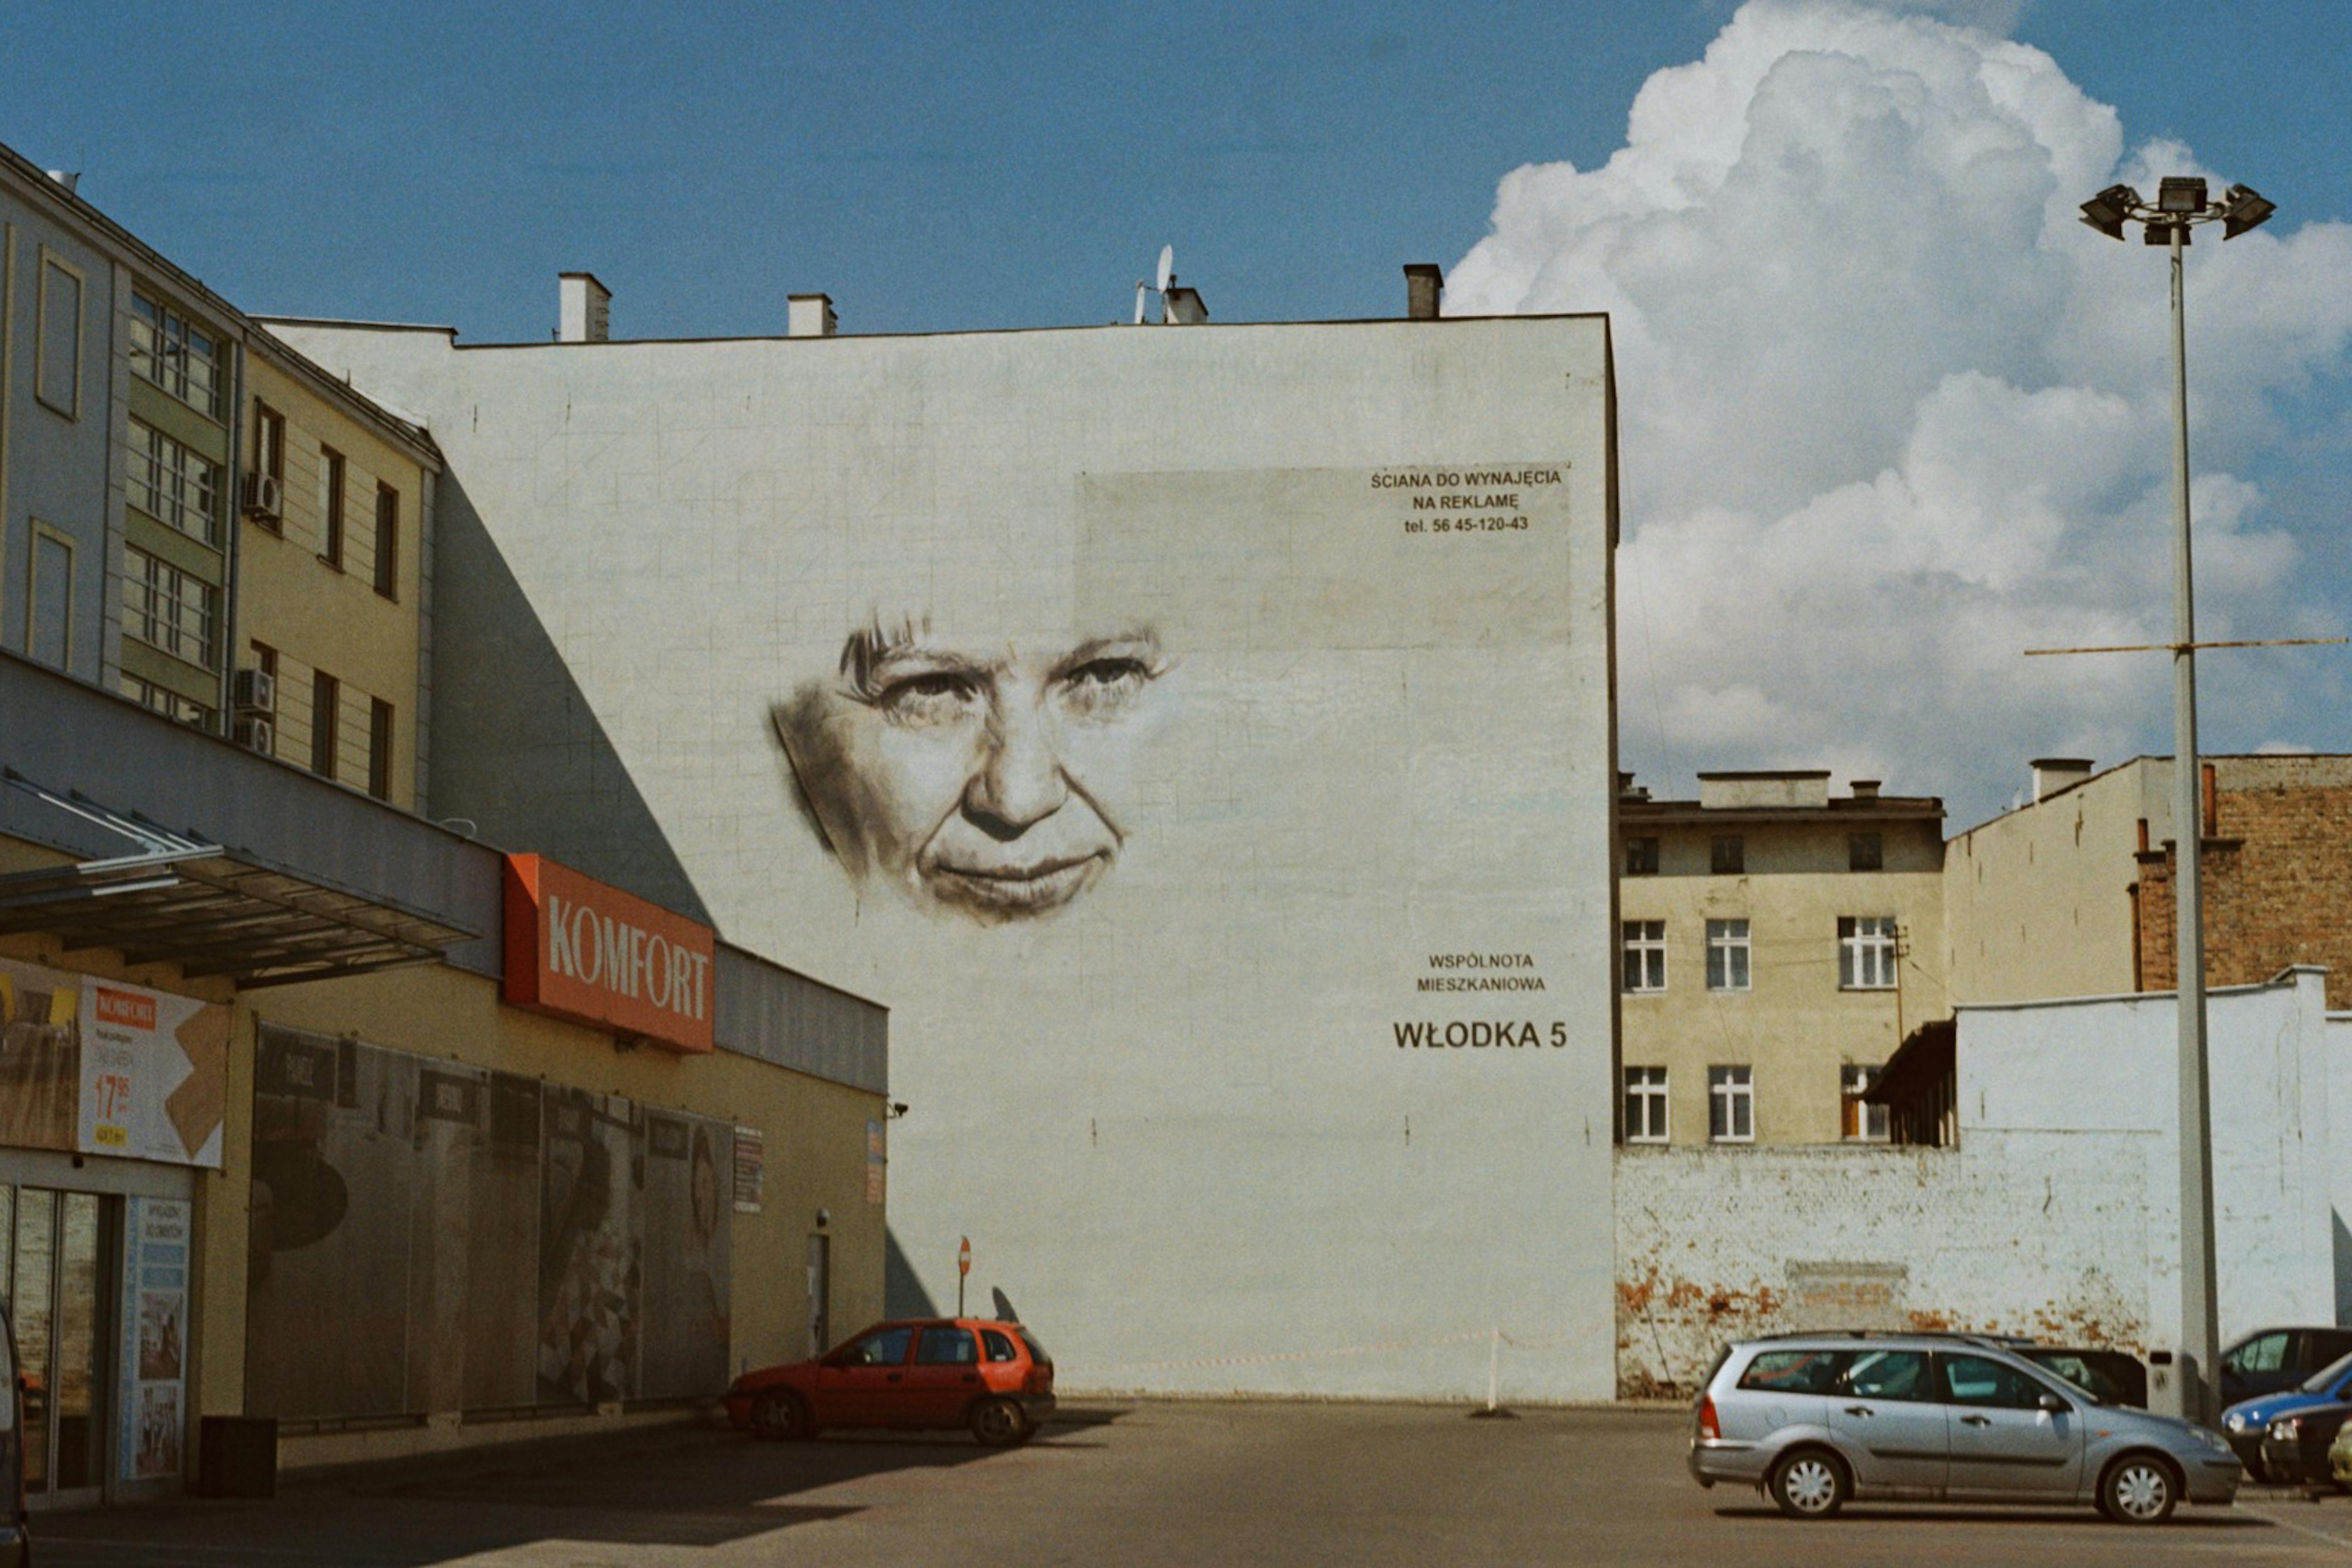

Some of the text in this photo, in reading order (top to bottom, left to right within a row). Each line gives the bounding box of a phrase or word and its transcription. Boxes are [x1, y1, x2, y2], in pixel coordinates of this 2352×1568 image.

[1371, 470, 1561, 488] ŚCIANA DO WYNAJĘCIA
[1414, 494, 1519, 509] NA REKLAMĘ
[1405, 516, 1528, 532] tel. 56 45-120-43
[549, 895, 708, 1020] KOMFORT
[1429, 952, 1534, 968] WSPÓLNOTA
[1417, 977, 1545, 991] MIESZKANIOWA
[1393, 1022, 1567, 1047] WŁODKA 5
